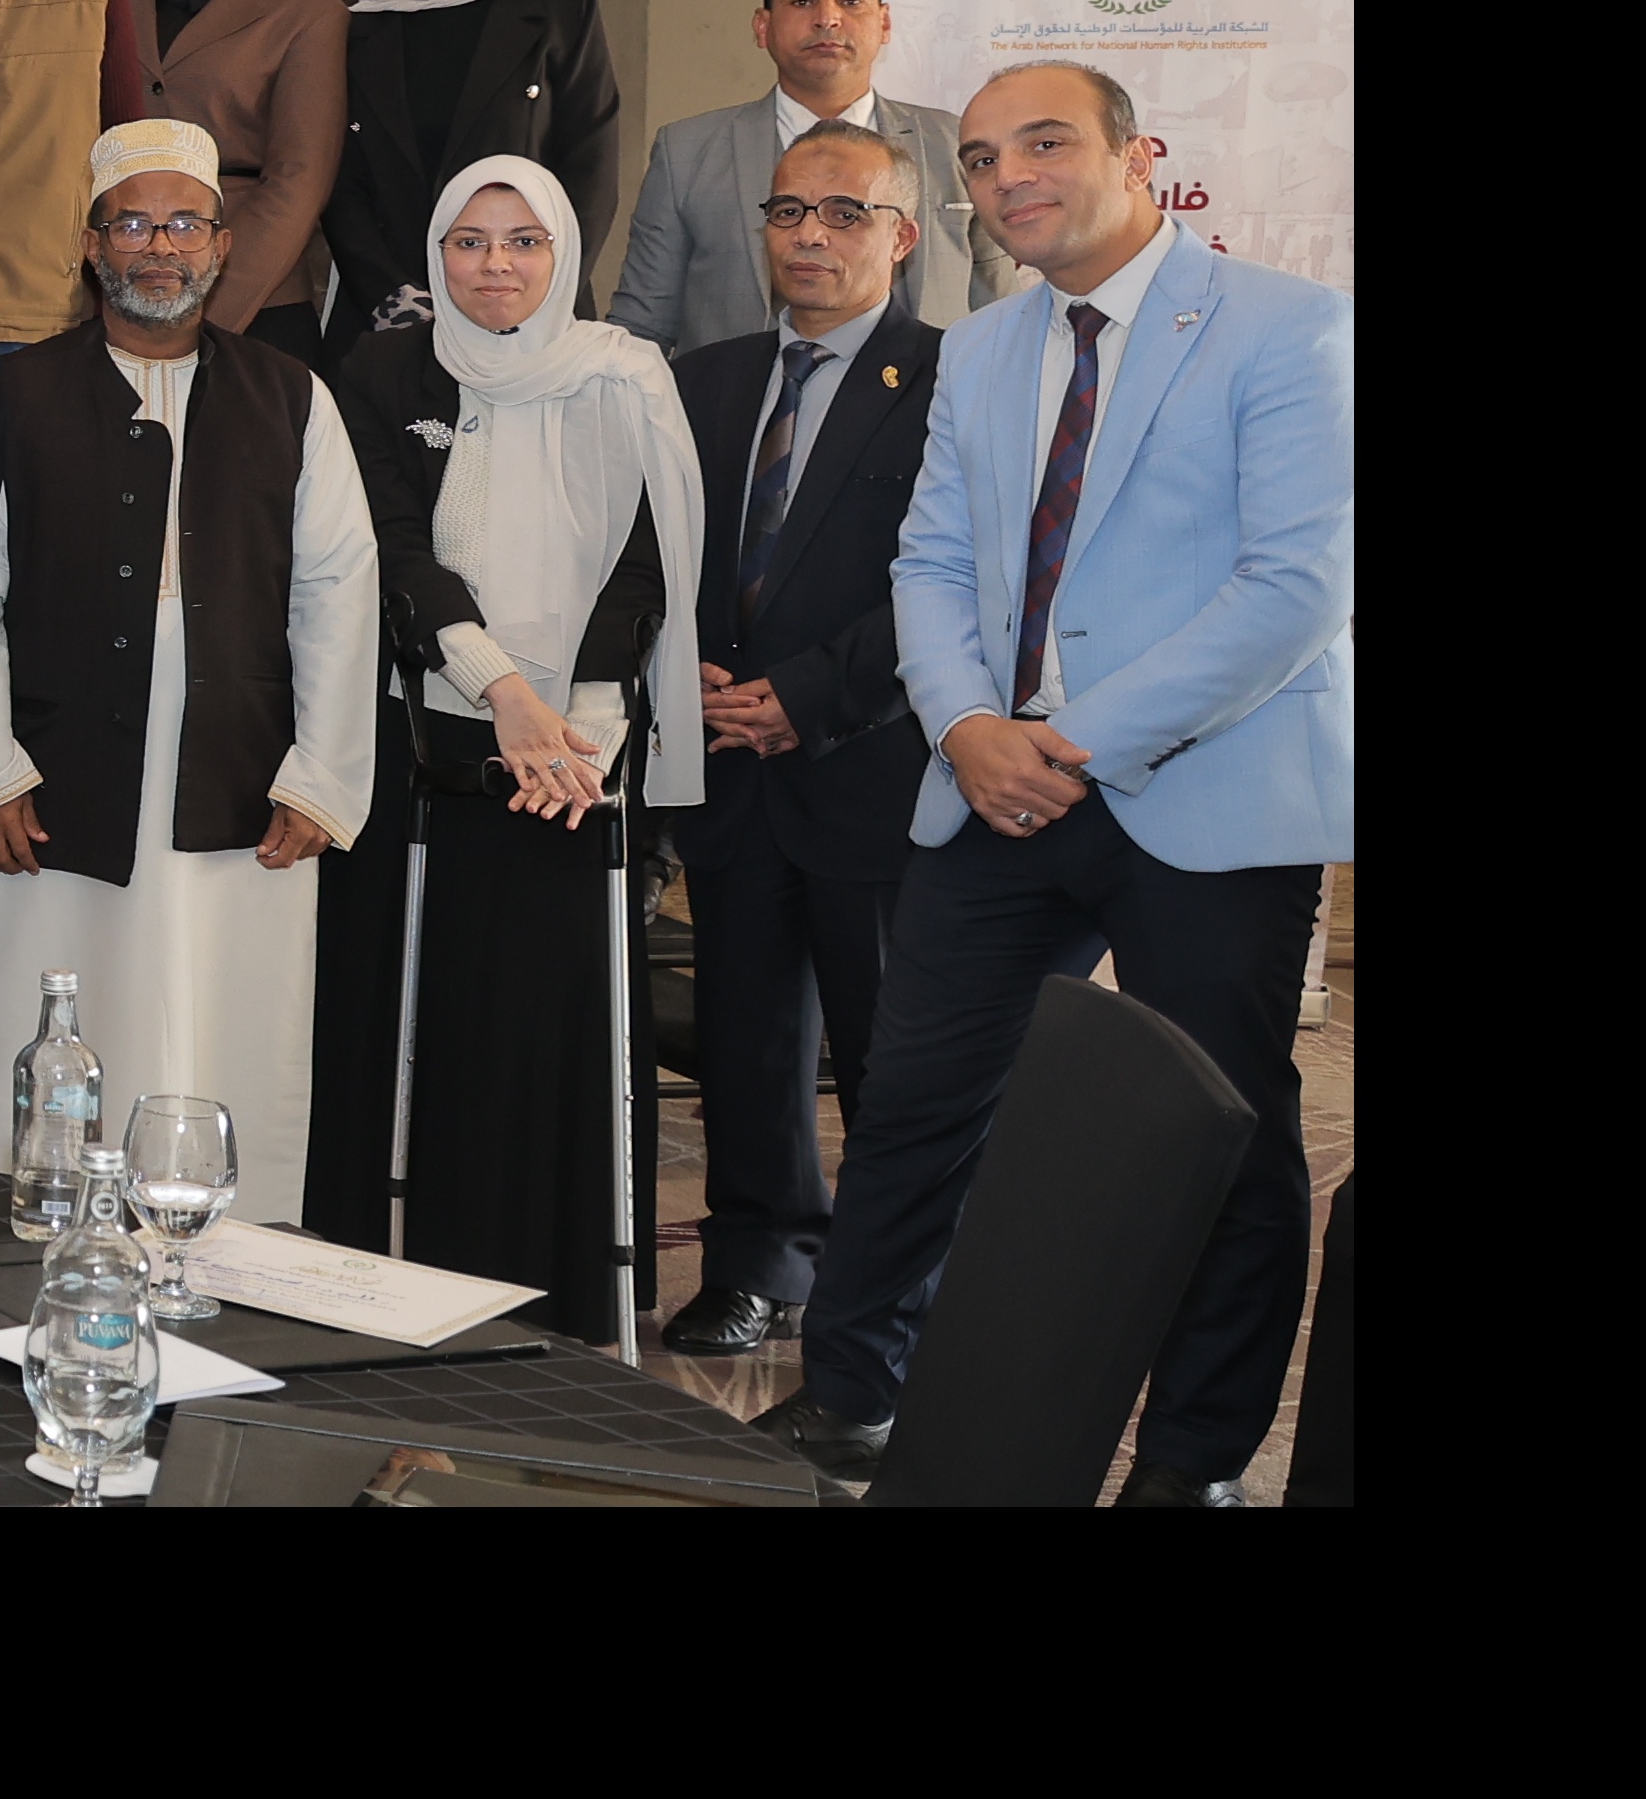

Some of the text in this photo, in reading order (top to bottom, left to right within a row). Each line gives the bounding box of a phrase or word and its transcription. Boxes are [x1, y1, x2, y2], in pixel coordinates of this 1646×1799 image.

[991, 22, 1268, 38] الشبكة العربية للمؤسسات الوطنية لحقوق الإنسان
[991, 40, 1267, 51] The Arab Network for National Human Rights Institutions
